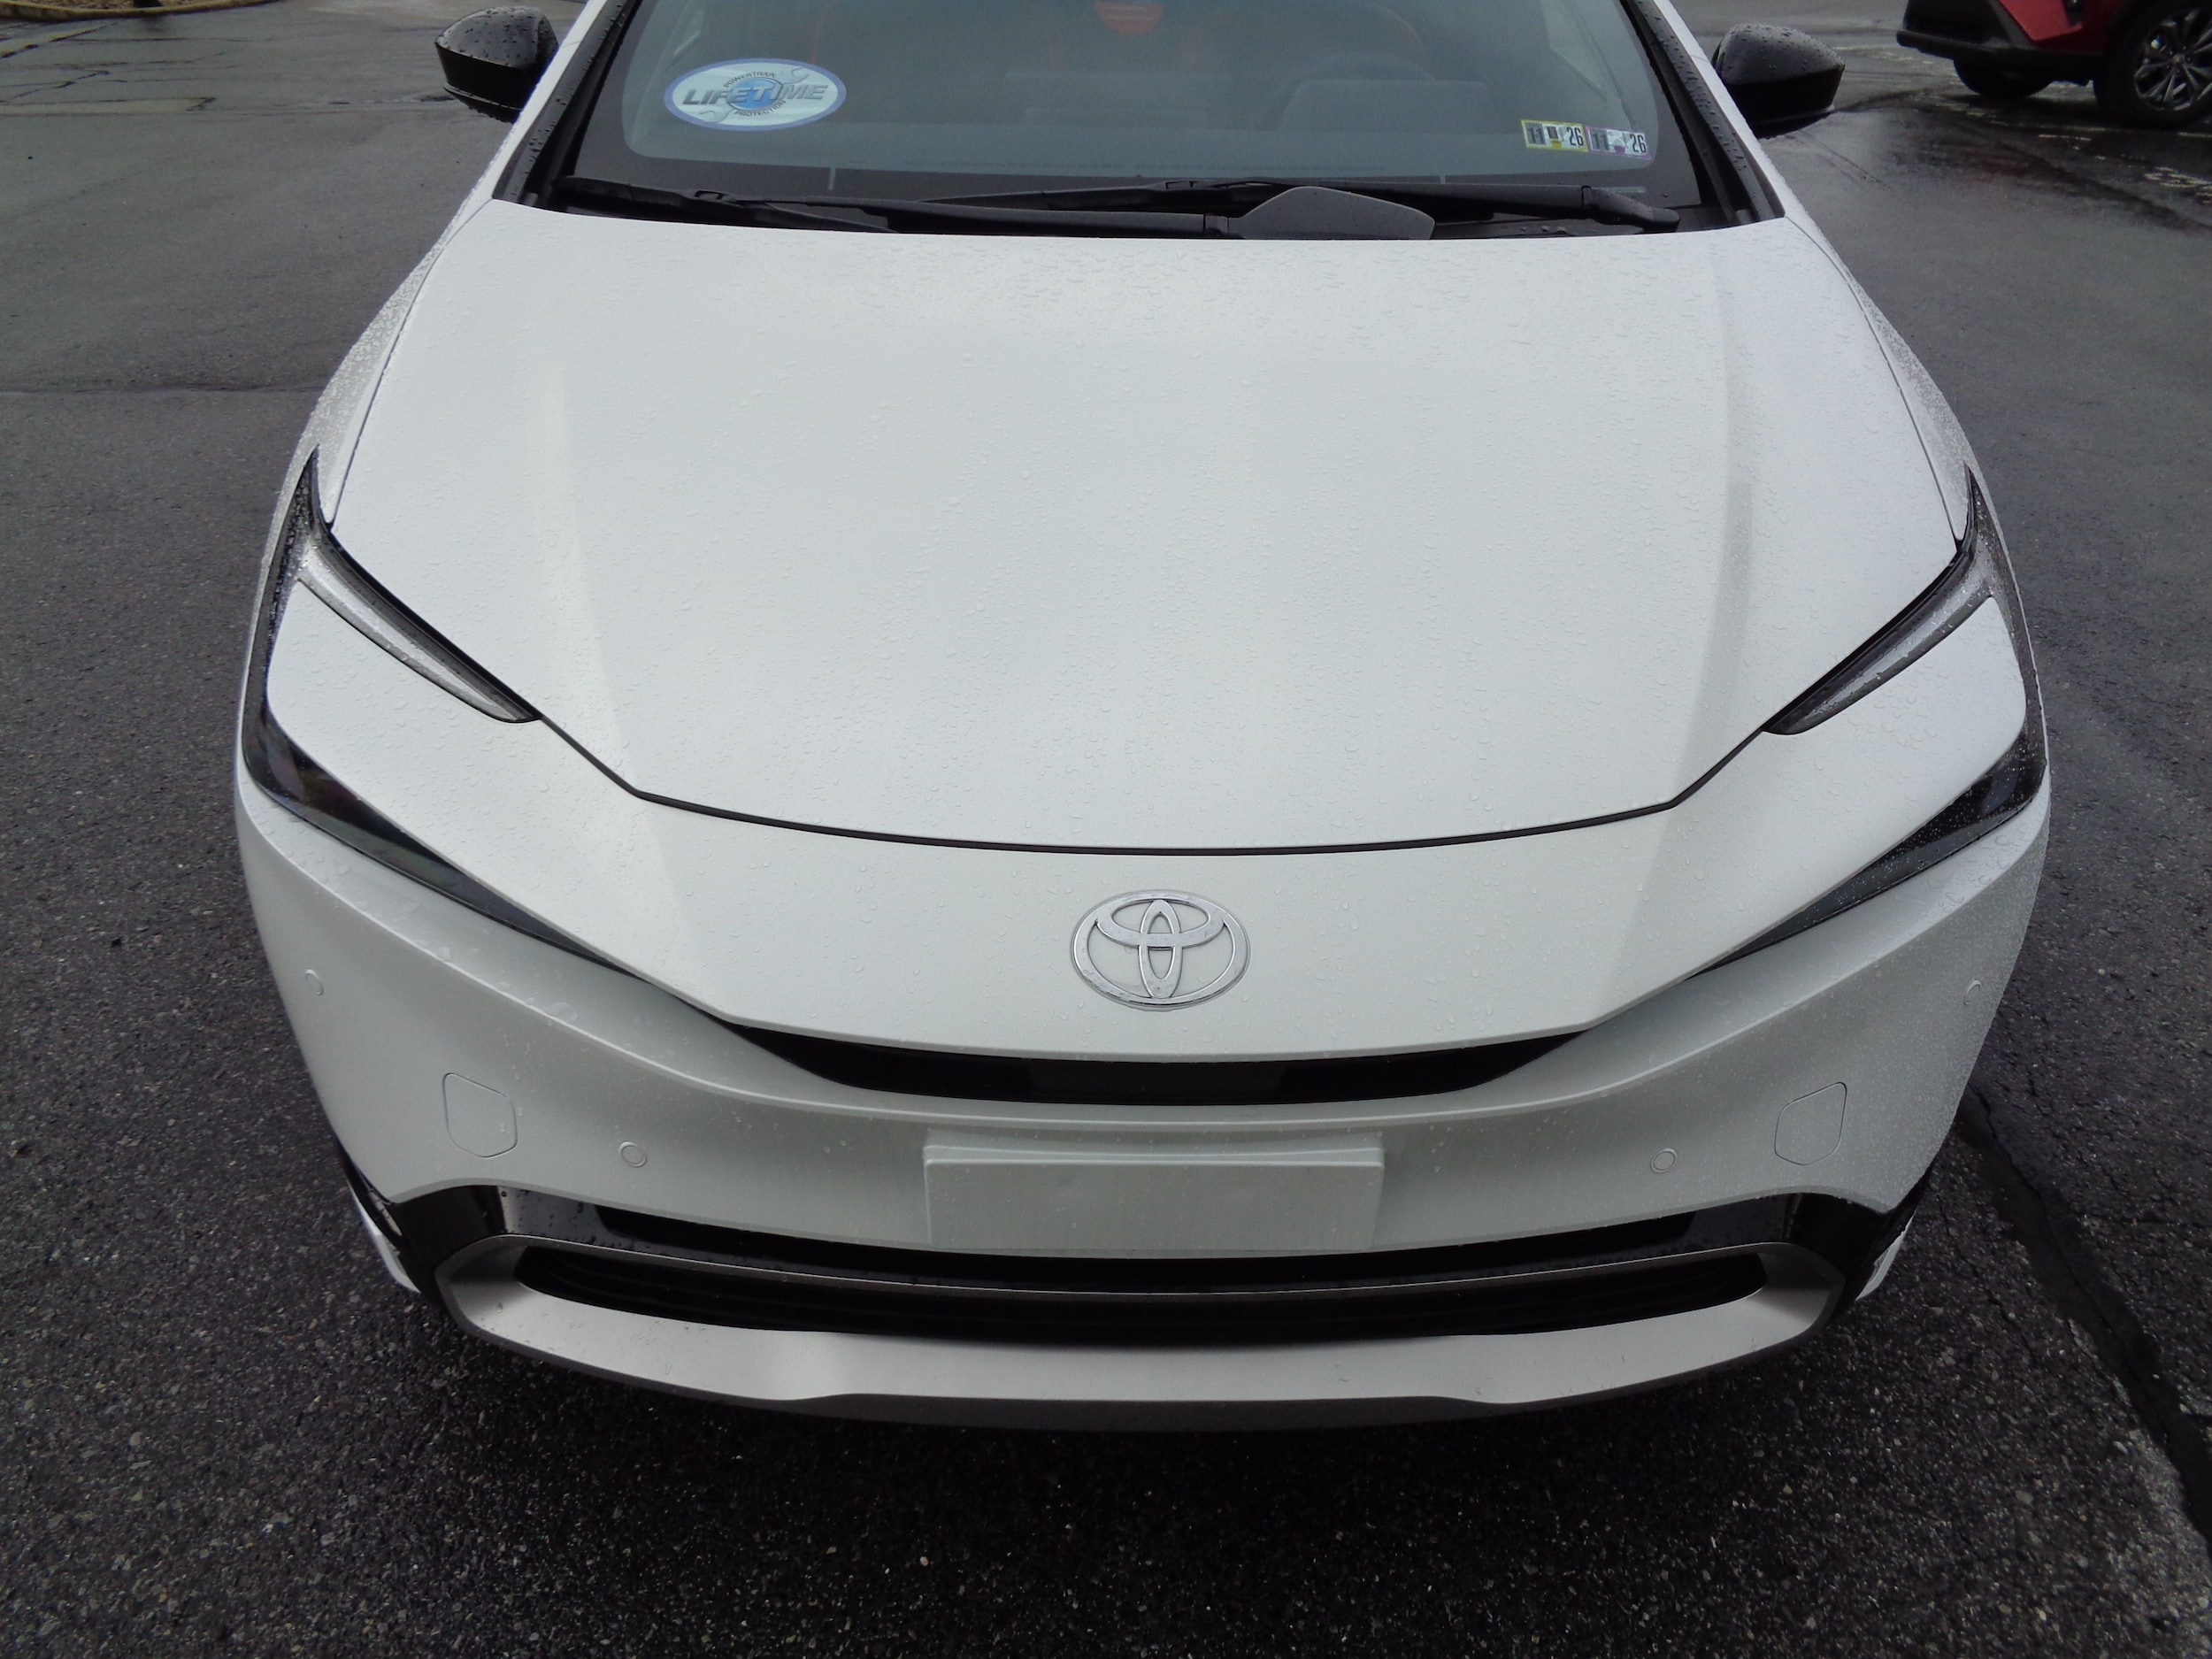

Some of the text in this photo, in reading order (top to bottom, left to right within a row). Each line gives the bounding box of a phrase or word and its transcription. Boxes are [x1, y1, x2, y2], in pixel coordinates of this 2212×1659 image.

[723, 72, 776, 88] POWERTRAIN
[682, 84, 828, 105] LIFETIME
[734, 98, 786, 117] PROTECTION
[1528, 127, 1584, 147] 11 26
[1592, 134, 1647, 153] 11 26
